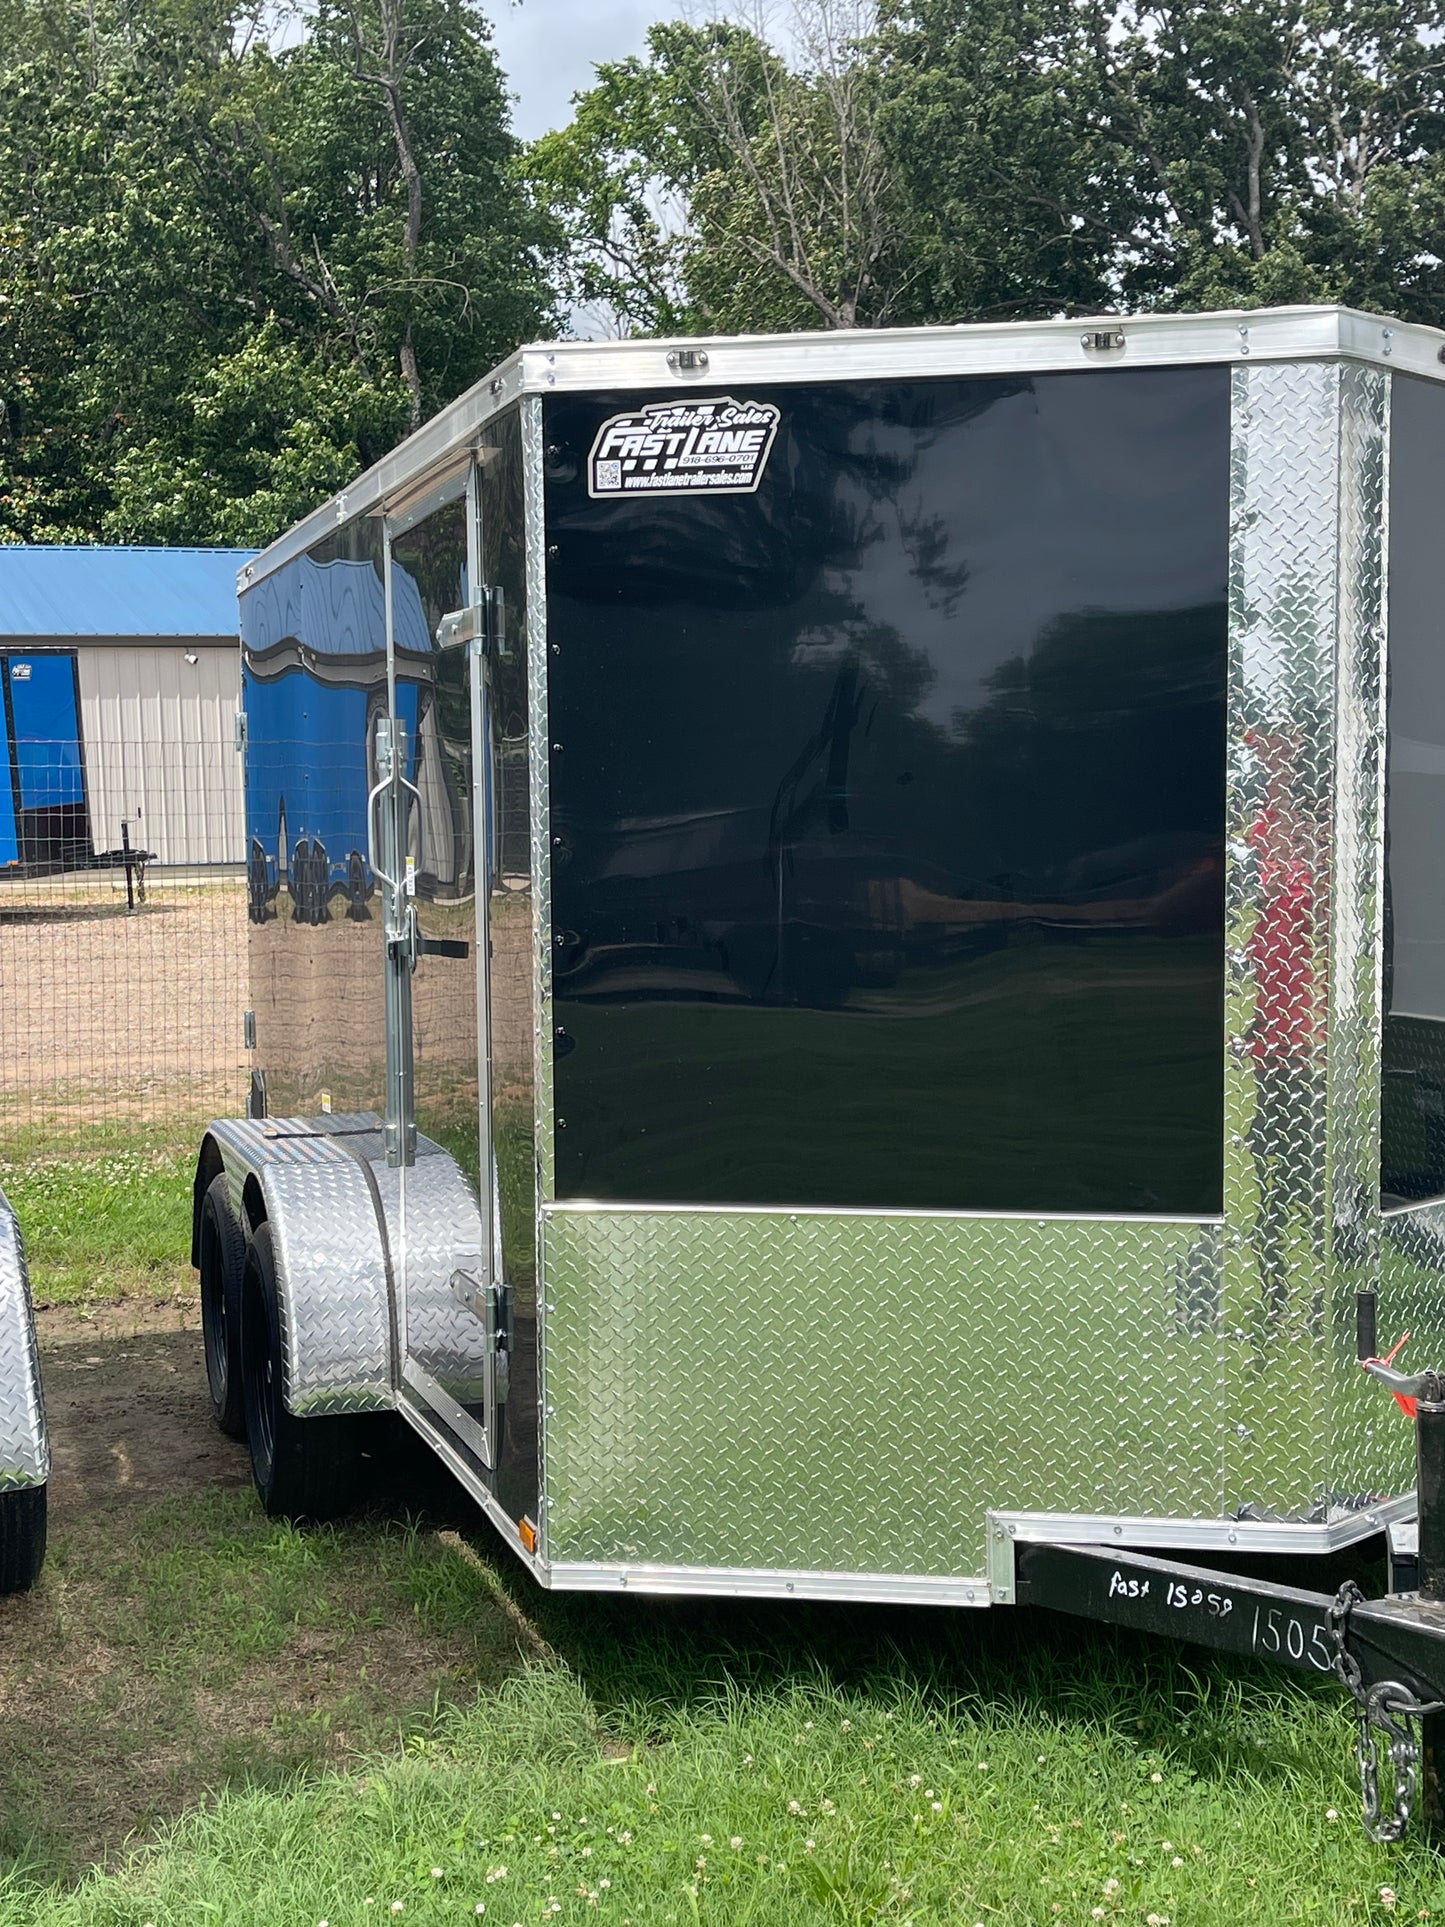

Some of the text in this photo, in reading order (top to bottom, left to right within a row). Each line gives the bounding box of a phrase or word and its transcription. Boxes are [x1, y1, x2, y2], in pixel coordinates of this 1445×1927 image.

[649, 407, 773, 431] Trailer Sales
[682, 454, 755, 465] 918-696-0701
[624, 471, 753, 489] www.fastlanetrailersales.com
[1252, 1605, 1338, 1671] 1505
